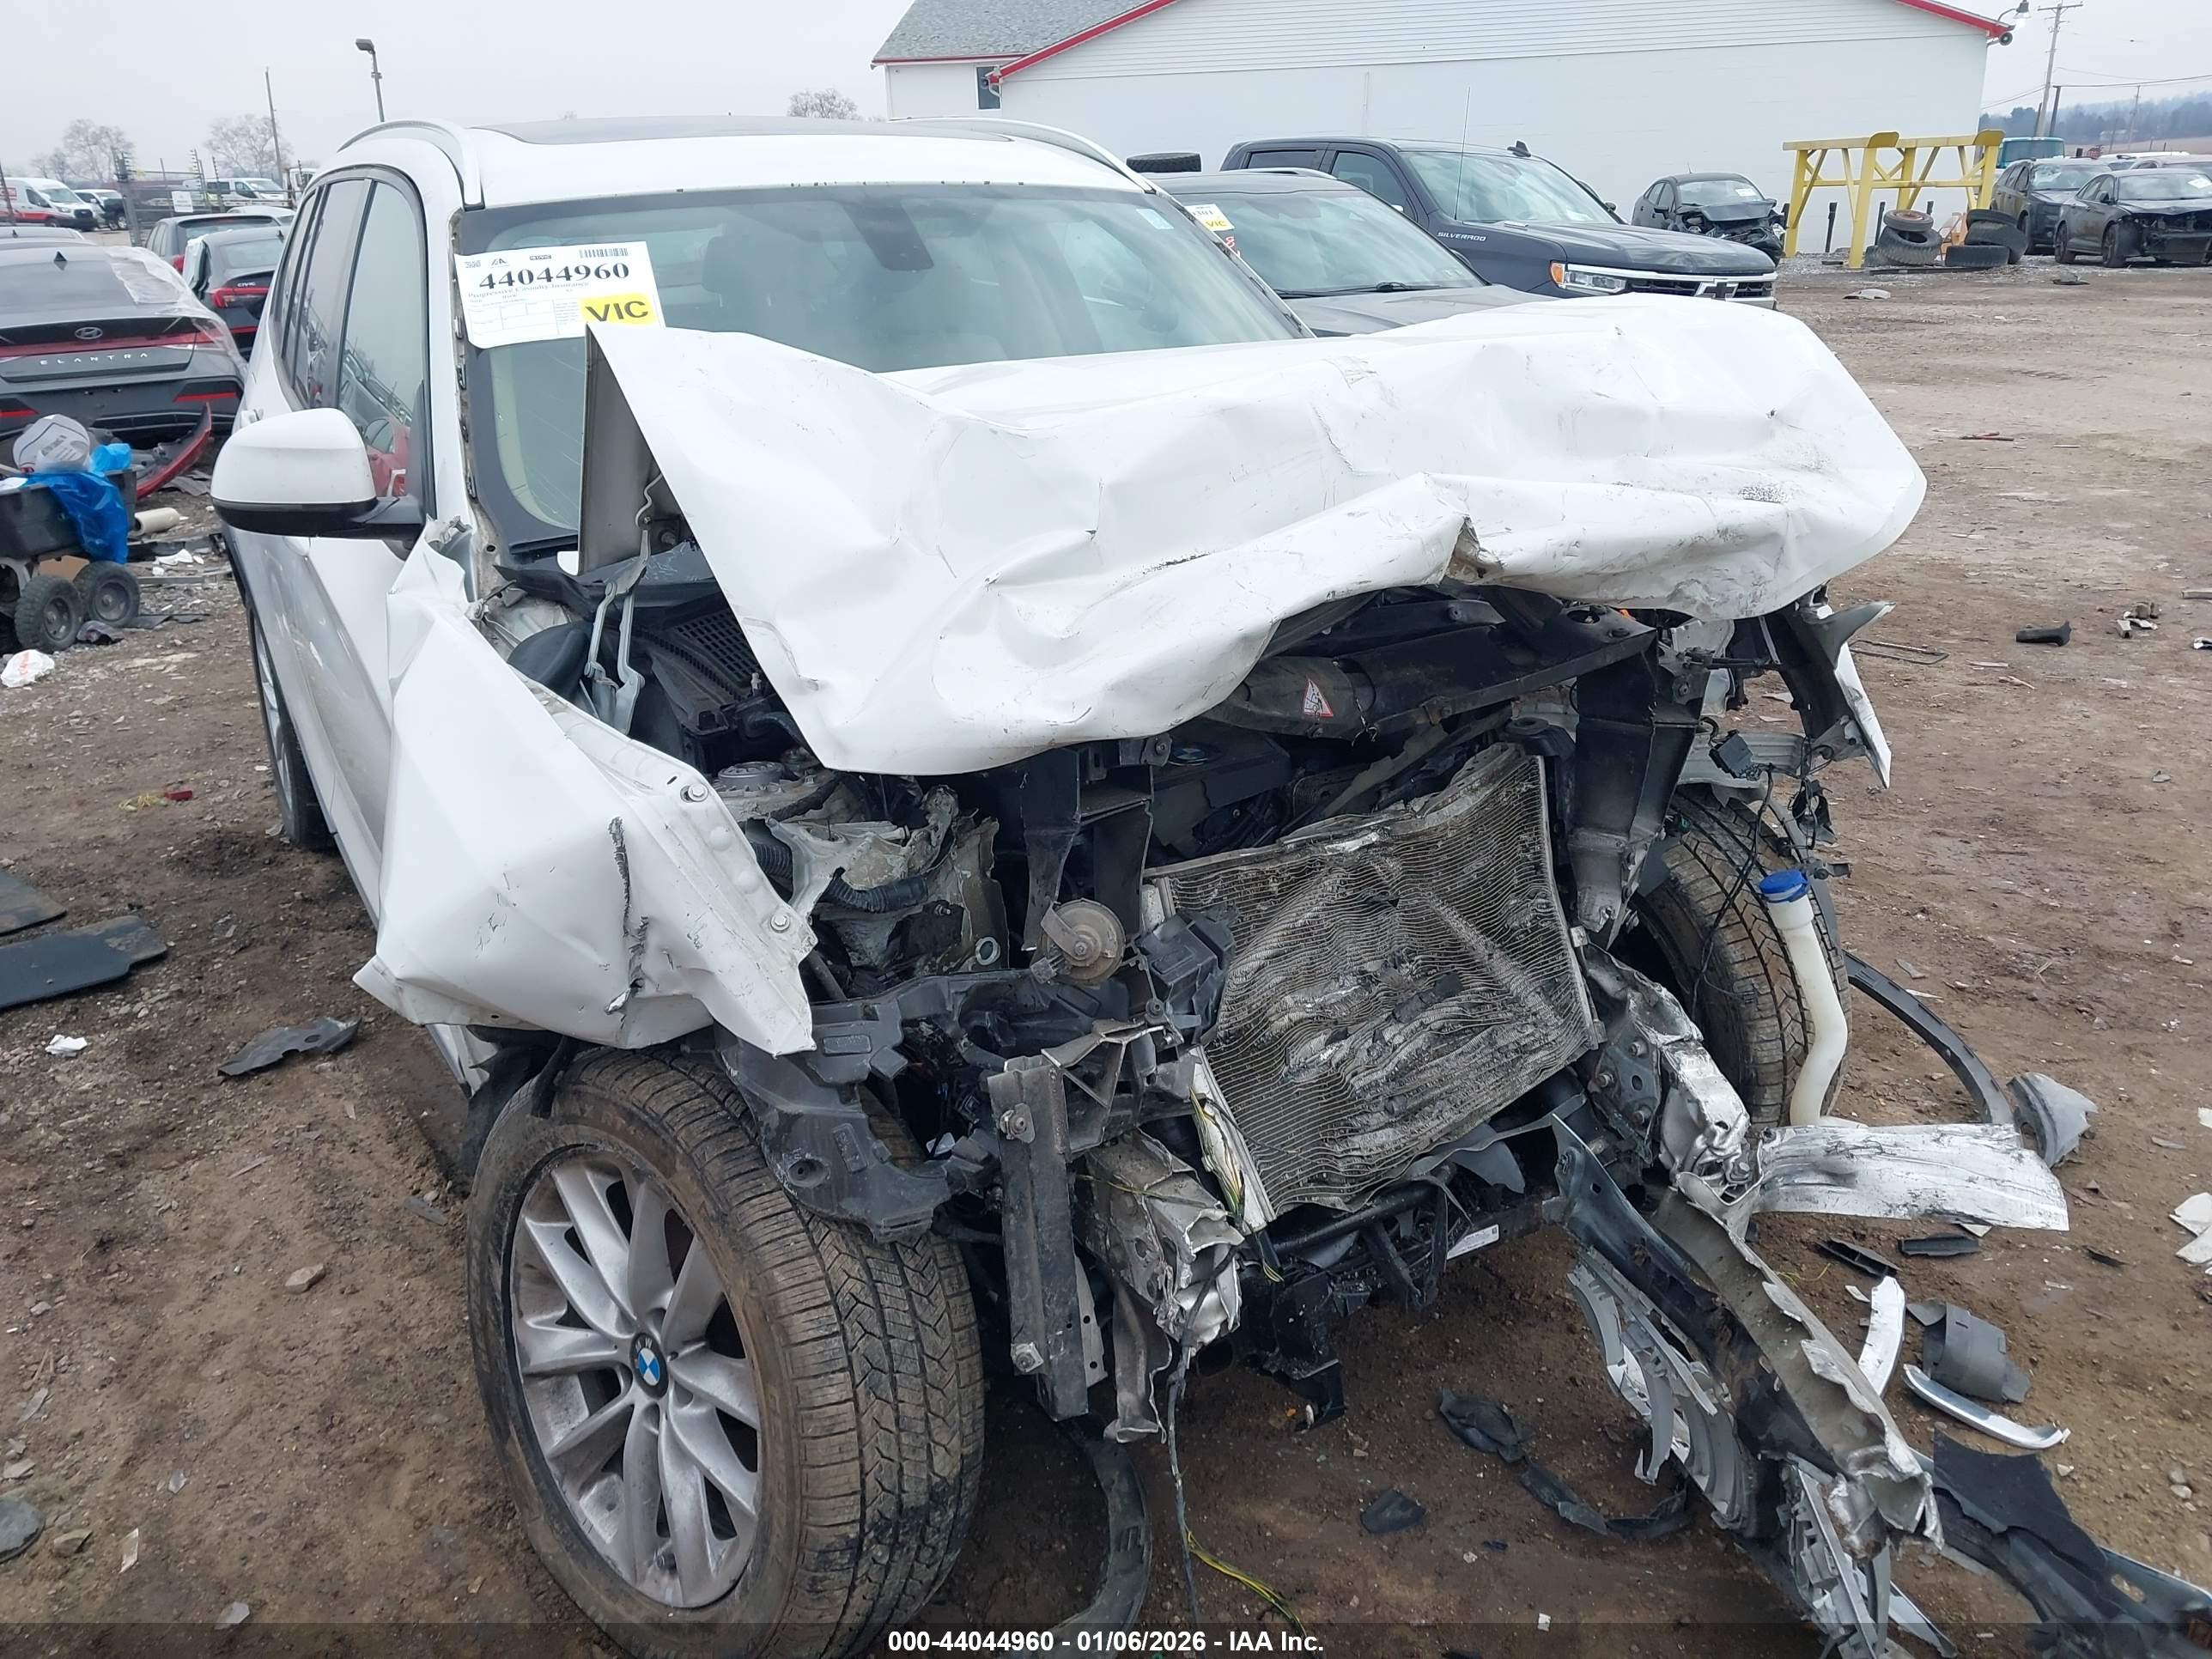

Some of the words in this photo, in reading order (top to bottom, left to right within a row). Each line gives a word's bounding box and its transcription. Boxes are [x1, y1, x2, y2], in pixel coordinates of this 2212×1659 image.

[1437, 232, 1486, 241] SILVERADO
[479, 263, 629, 289] 44044960
[585, 301, 648, 322] VIC
[40, 352, 149, 365] ELANTRA
